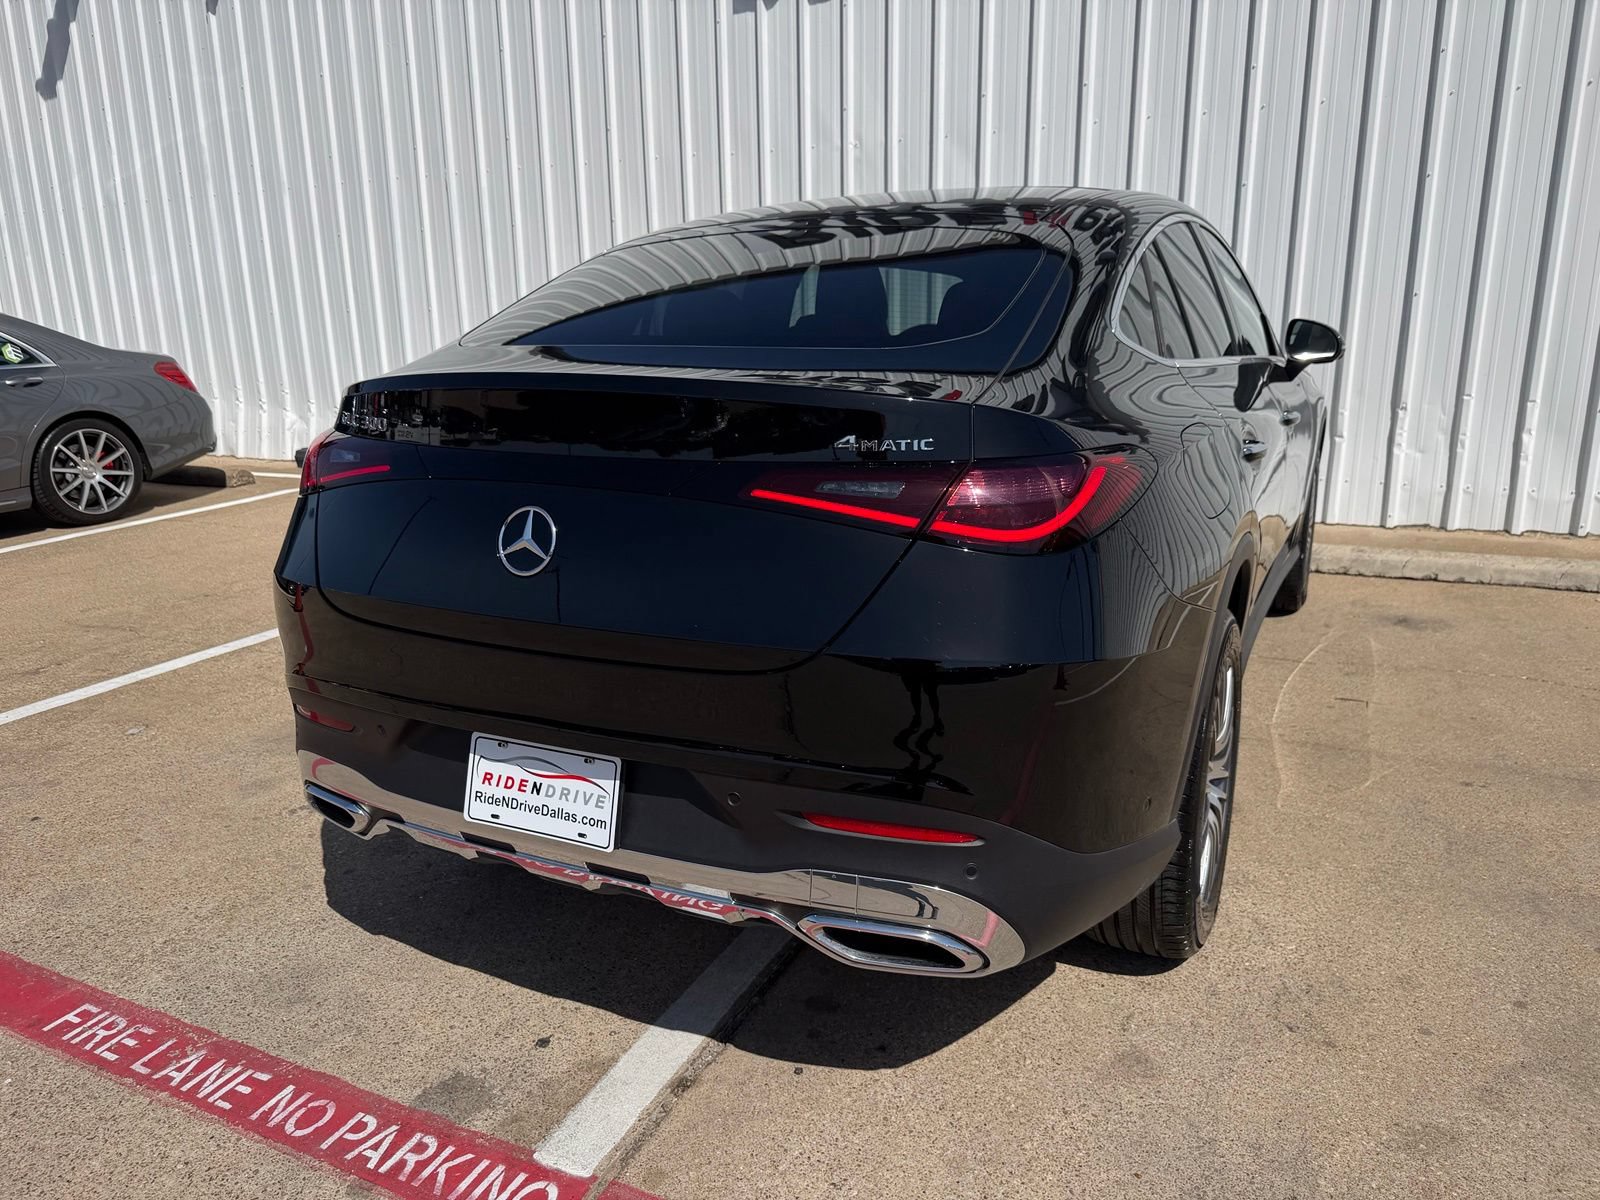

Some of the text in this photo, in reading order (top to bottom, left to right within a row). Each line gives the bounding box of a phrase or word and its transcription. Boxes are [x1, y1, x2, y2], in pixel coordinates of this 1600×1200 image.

[360, 414, 388, 432] 300
[834, 435, 935, 452] 4MATIC
[474, 790, 607, 830] RideNDriveDallas.com
[481, 771, 607, 810] RIDENDRIVE
[42, 1003, 157, 1061] FIRE
[129, 1038, 273, 1110] LANE
[249, 1084, 337, 1138] NO
